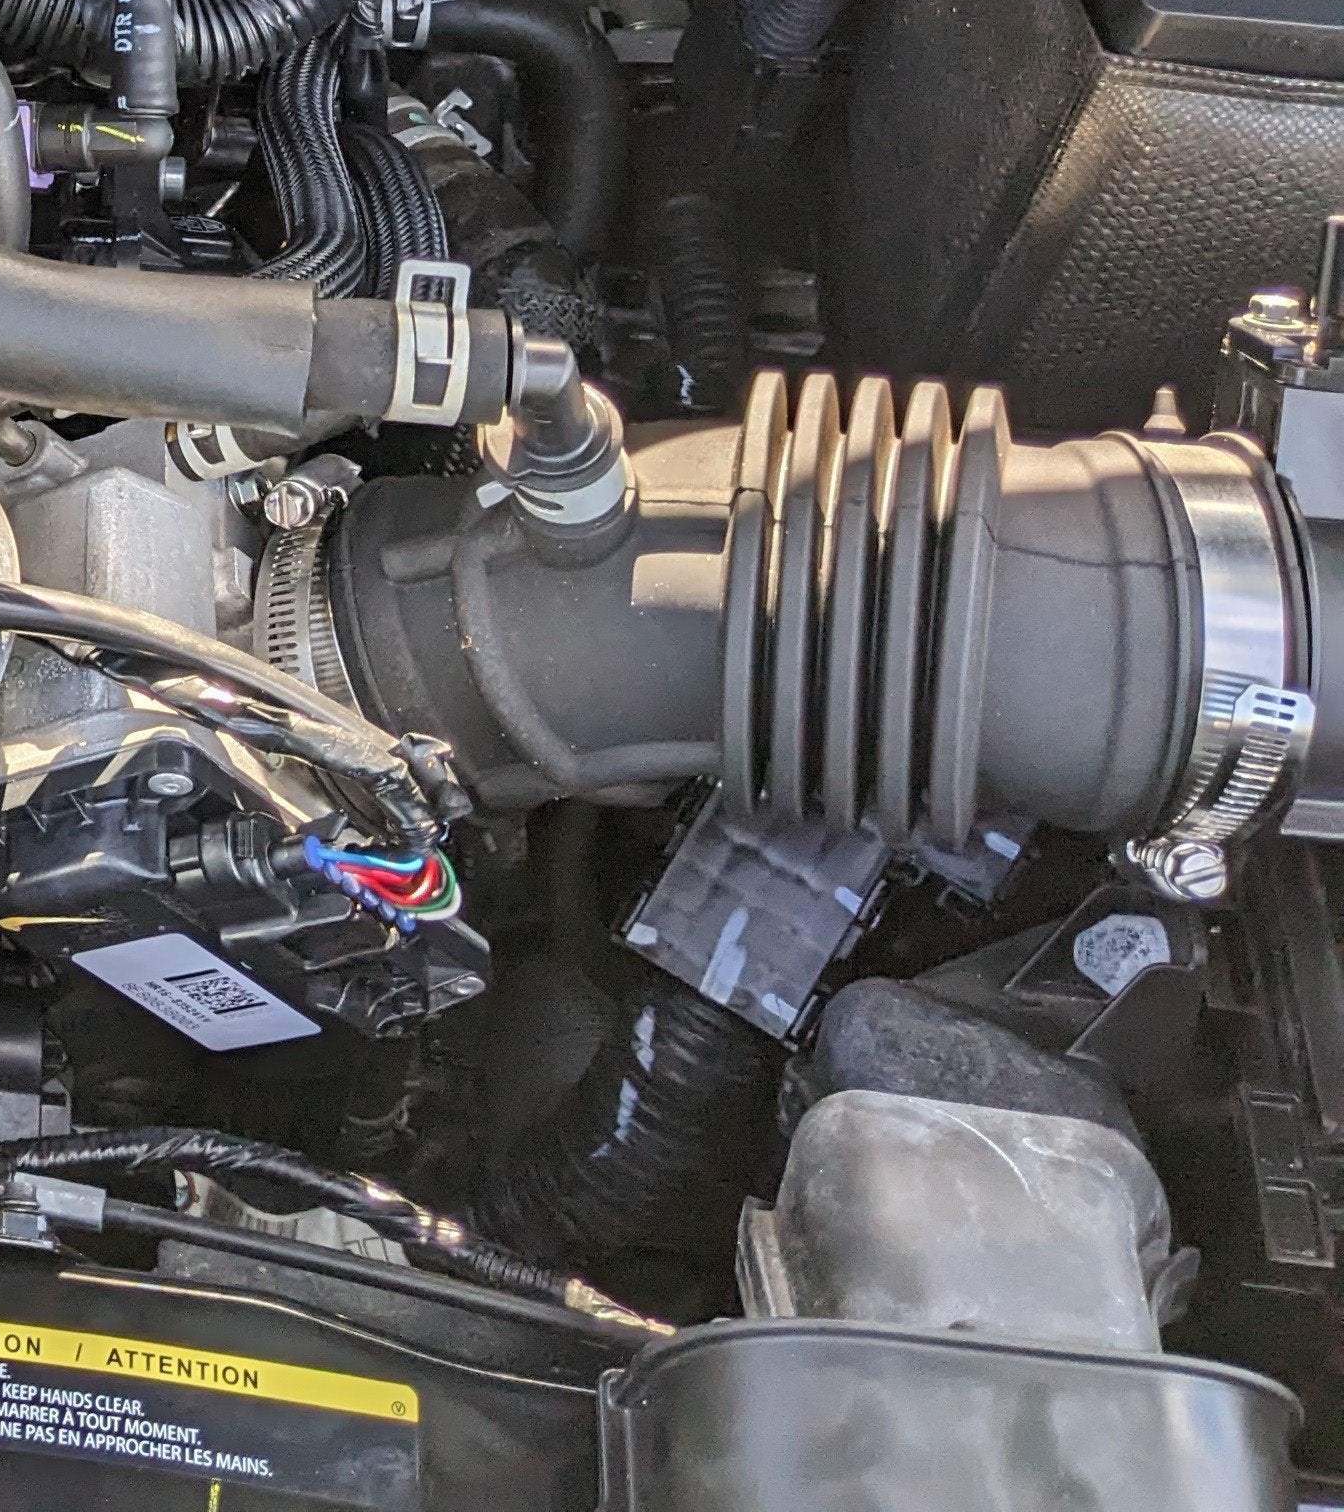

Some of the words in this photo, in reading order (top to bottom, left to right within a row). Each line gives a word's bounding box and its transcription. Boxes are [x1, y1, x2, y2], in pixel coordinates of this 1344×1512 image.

[114, 12, 133, 53] DTR
[105, 1347, 260, 1389] ATTENTION
[2, 1382, 38, 1402] KEEP
[40, 1388, 93, 1410] HANDS
[94, 1395, 145, 1417] CLEAR.
[61, 1405, 75, 1424] À
[77, 1410, 123, 1432] TOUT
[124, 1419, 202, 1446] MOMENT.
[0, 1420, 23, 1439] NE
[24, 1424, 56, 1445] PAS
[57, 1428, 82, 1448] EN
[84, 1433, 183, 1462] APPROCHER
[184, 1445, 213, 1468] LES
[214, 1451, 274, 1478] MAINS.
